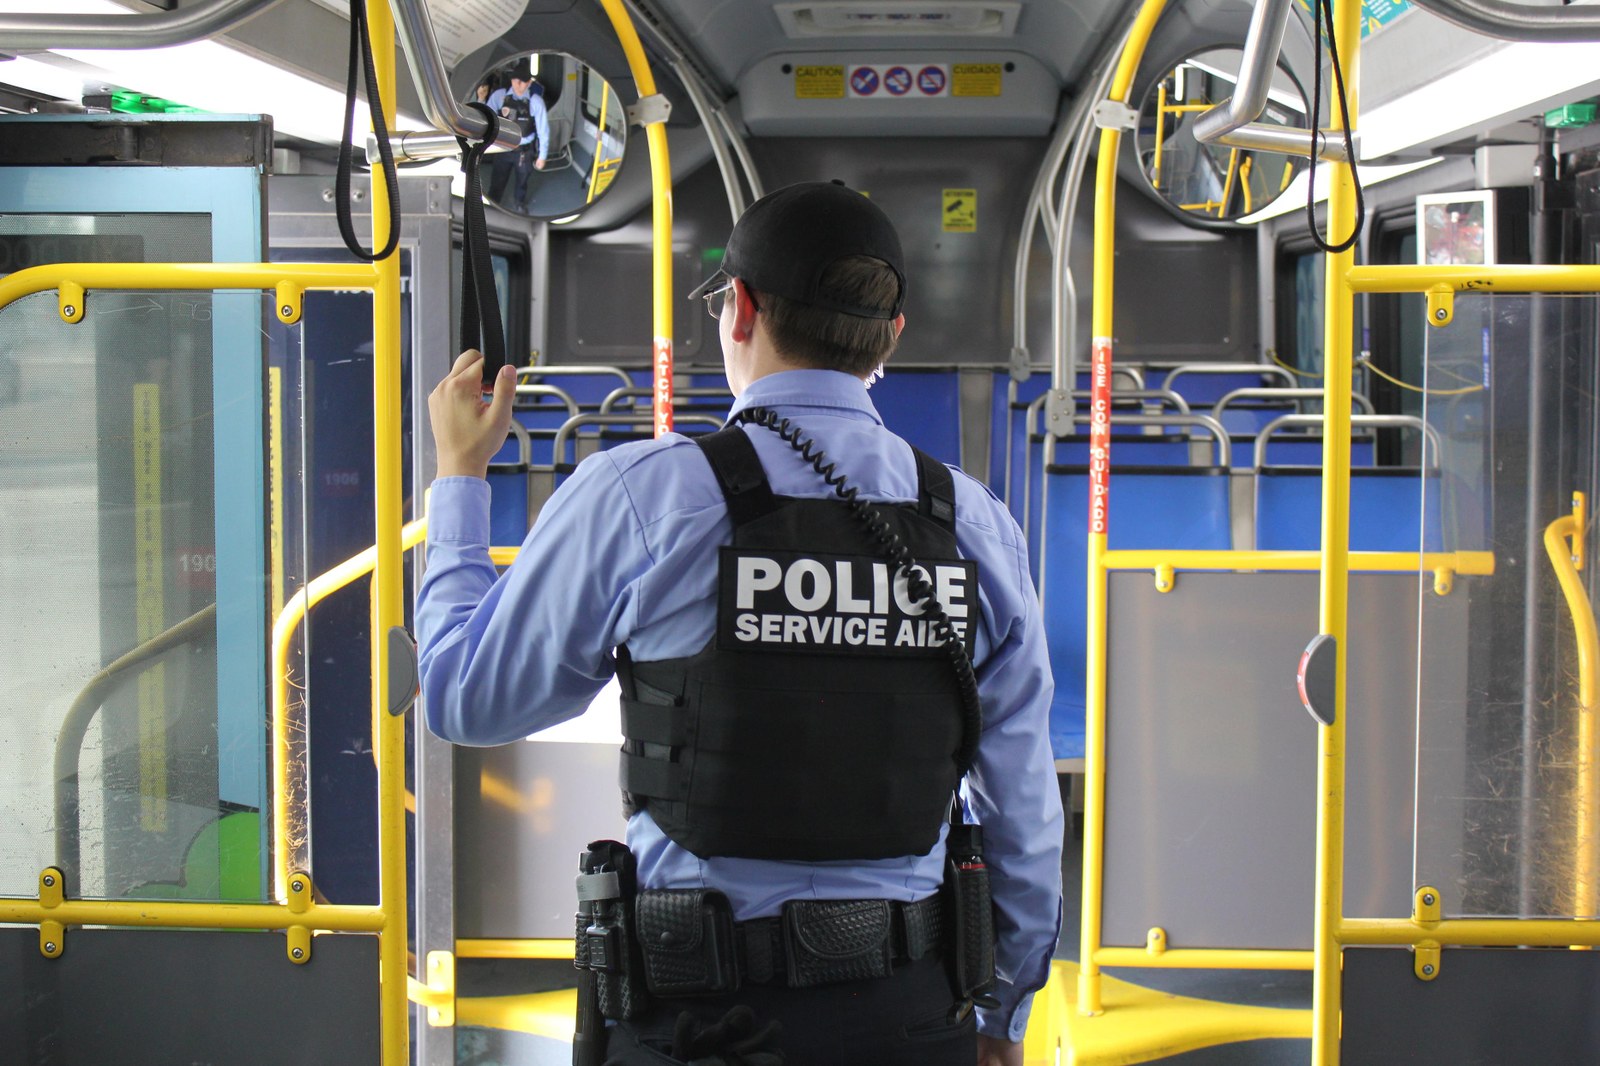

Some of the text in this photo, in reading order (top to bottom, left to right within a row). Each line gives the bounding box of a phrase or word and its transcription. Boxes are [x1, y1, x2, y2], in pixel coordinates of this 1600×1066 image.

[1095, 400, 1106, 435] CON
[736, 556, 968, 617] POLICE
[734, 613, 888, 646] SERVICE
